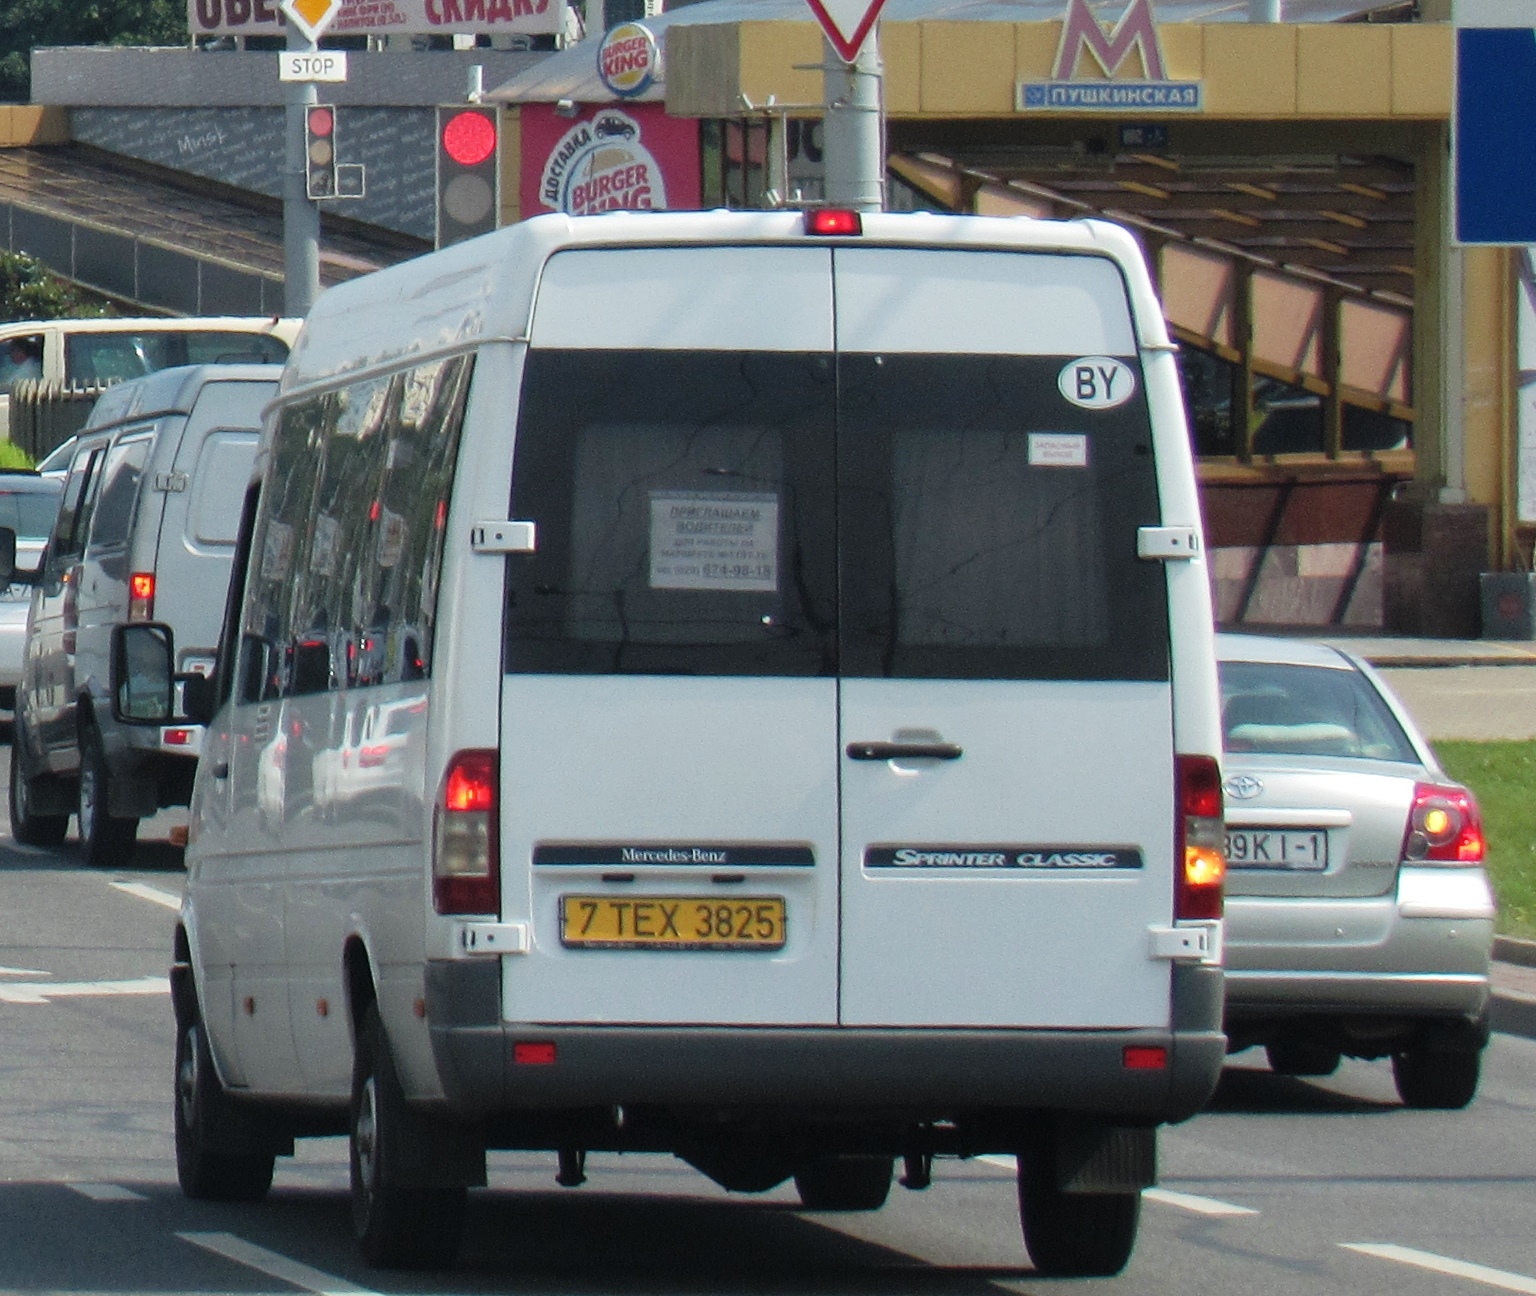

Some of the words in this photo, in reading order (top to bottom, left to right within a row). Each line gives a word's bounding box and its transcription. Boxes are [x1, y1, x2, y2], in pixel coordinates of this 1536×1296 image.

[601, 36, 647, 60] BURGER
[291, 57, 335, 75] STOP
[602, 50, 649, 77] KING
[1051, 87, 1196, 104] ПУШКИНСКАЯ
[544, 127, 592, 202] ДОСТАВКА
[571, 163, 649, 210] BURGER
[1075, 365, 1119, 400] BY
[621, 847, 727, 863] Mercedes-Benz
[1016, 853, 1117, 868] CLASSIC
[579, 901, 599, 936] 7
[609, 902, 681, 938] TEX
[695, 904, 775, 939] 3825
